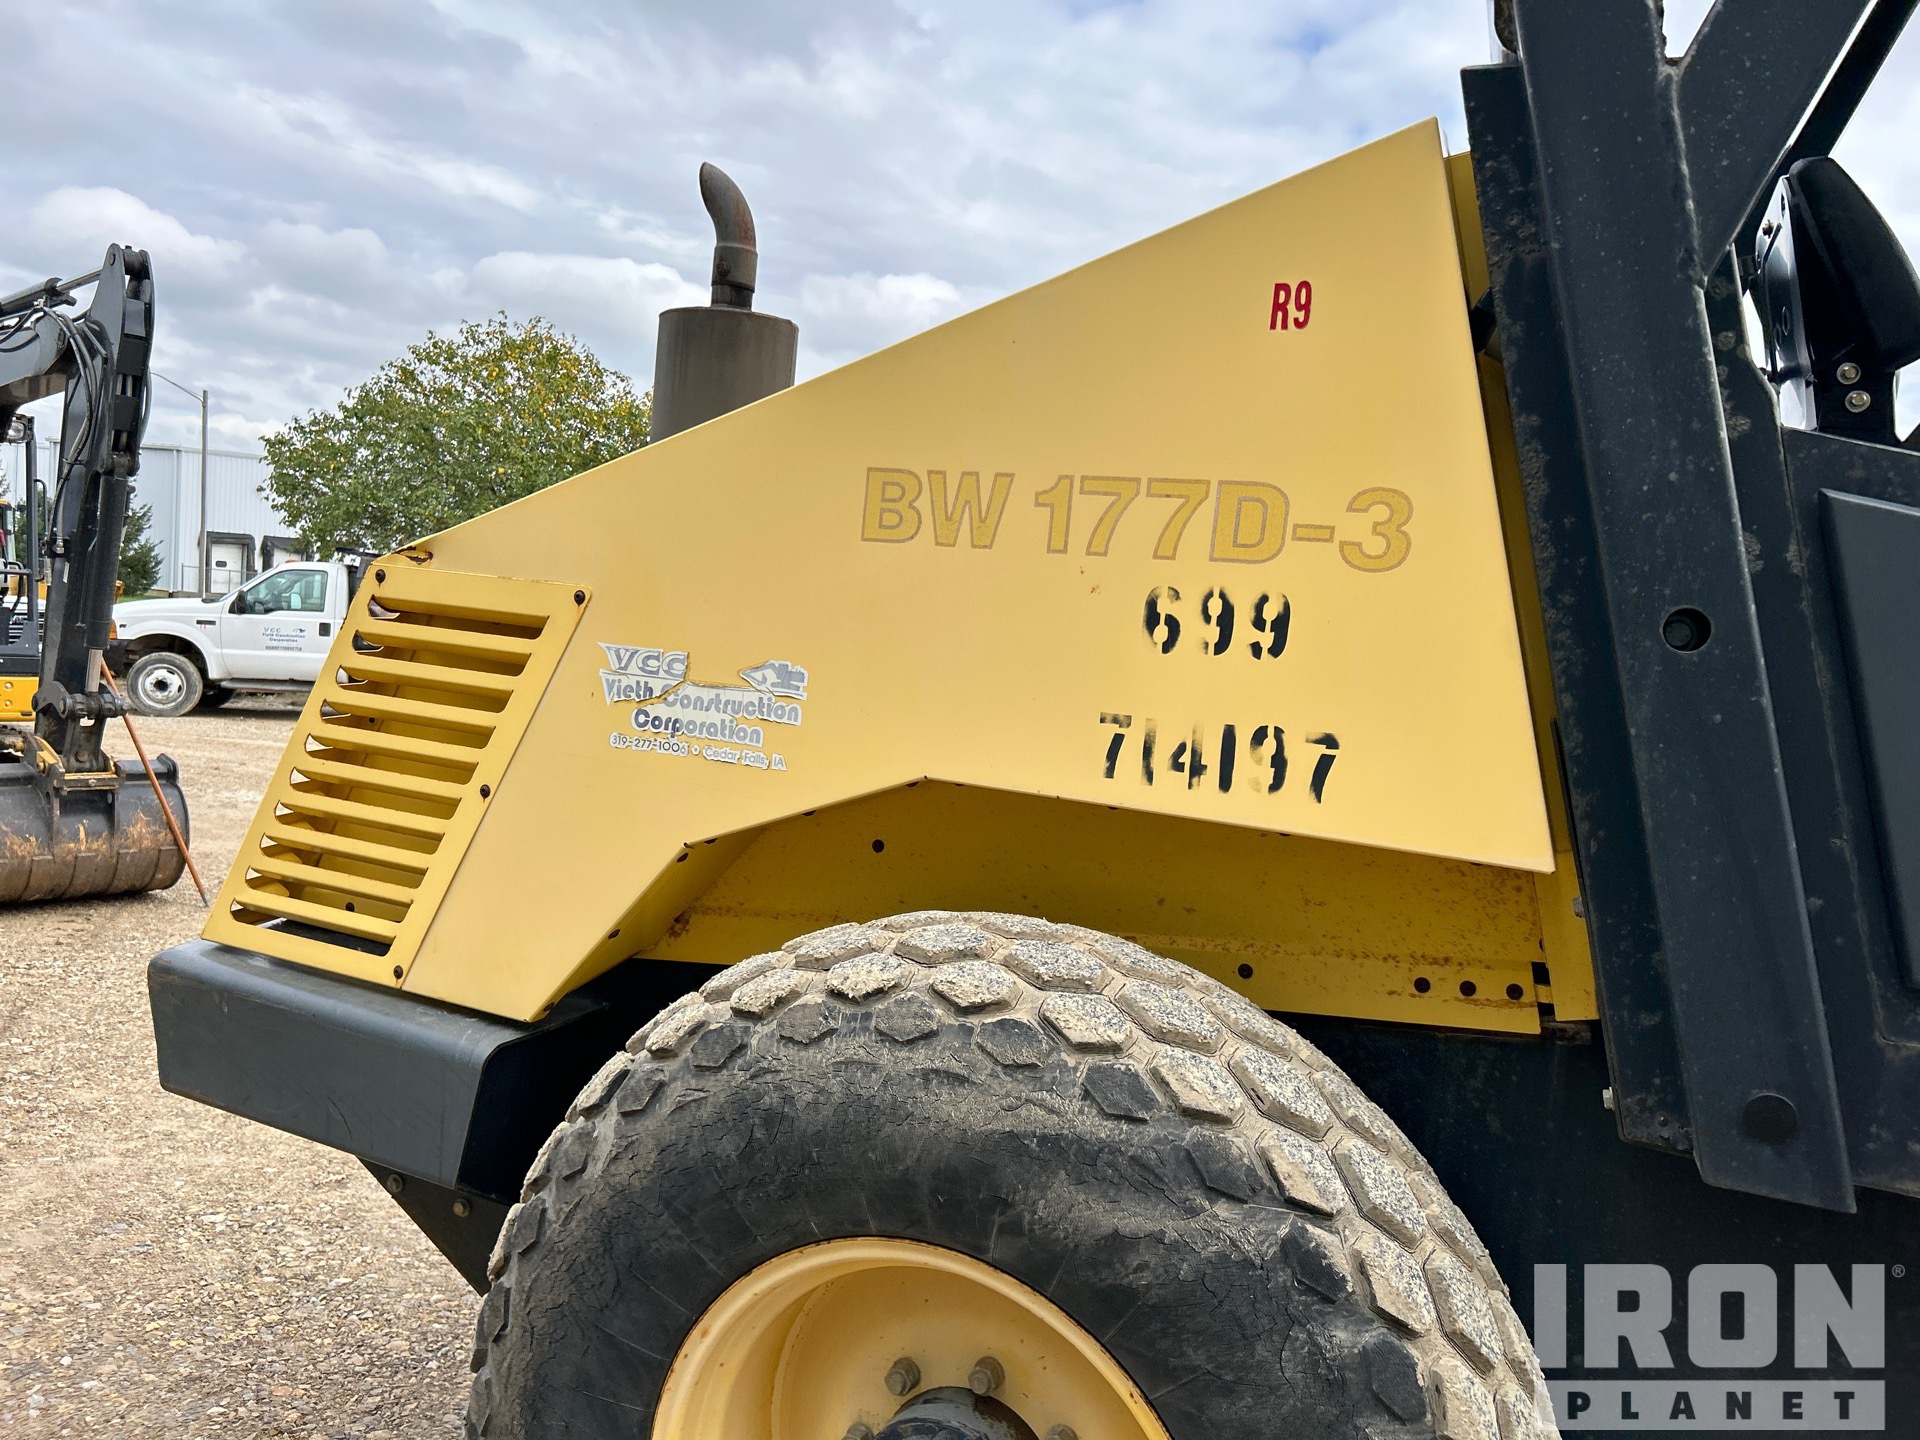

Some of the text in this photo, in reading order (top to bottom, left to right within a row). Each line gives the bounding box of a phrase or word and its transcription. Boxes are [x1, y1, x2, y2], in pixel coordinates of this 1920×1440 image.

[1269, 280, 1312, 331] R9
[861, 467, 1414, 573] BW 177D-3
[1143, 586, 1292, 661] 699
[605, 646, 687, 679] VCC
[604, 678, 800, 722] Vieth Construction
[634, 708, 762, 745] Corporation
[611, 734, 687, 754] 319-277-1006
[705, 746, 738, 761] Cedar
[773, 755, 785, 768] IA
